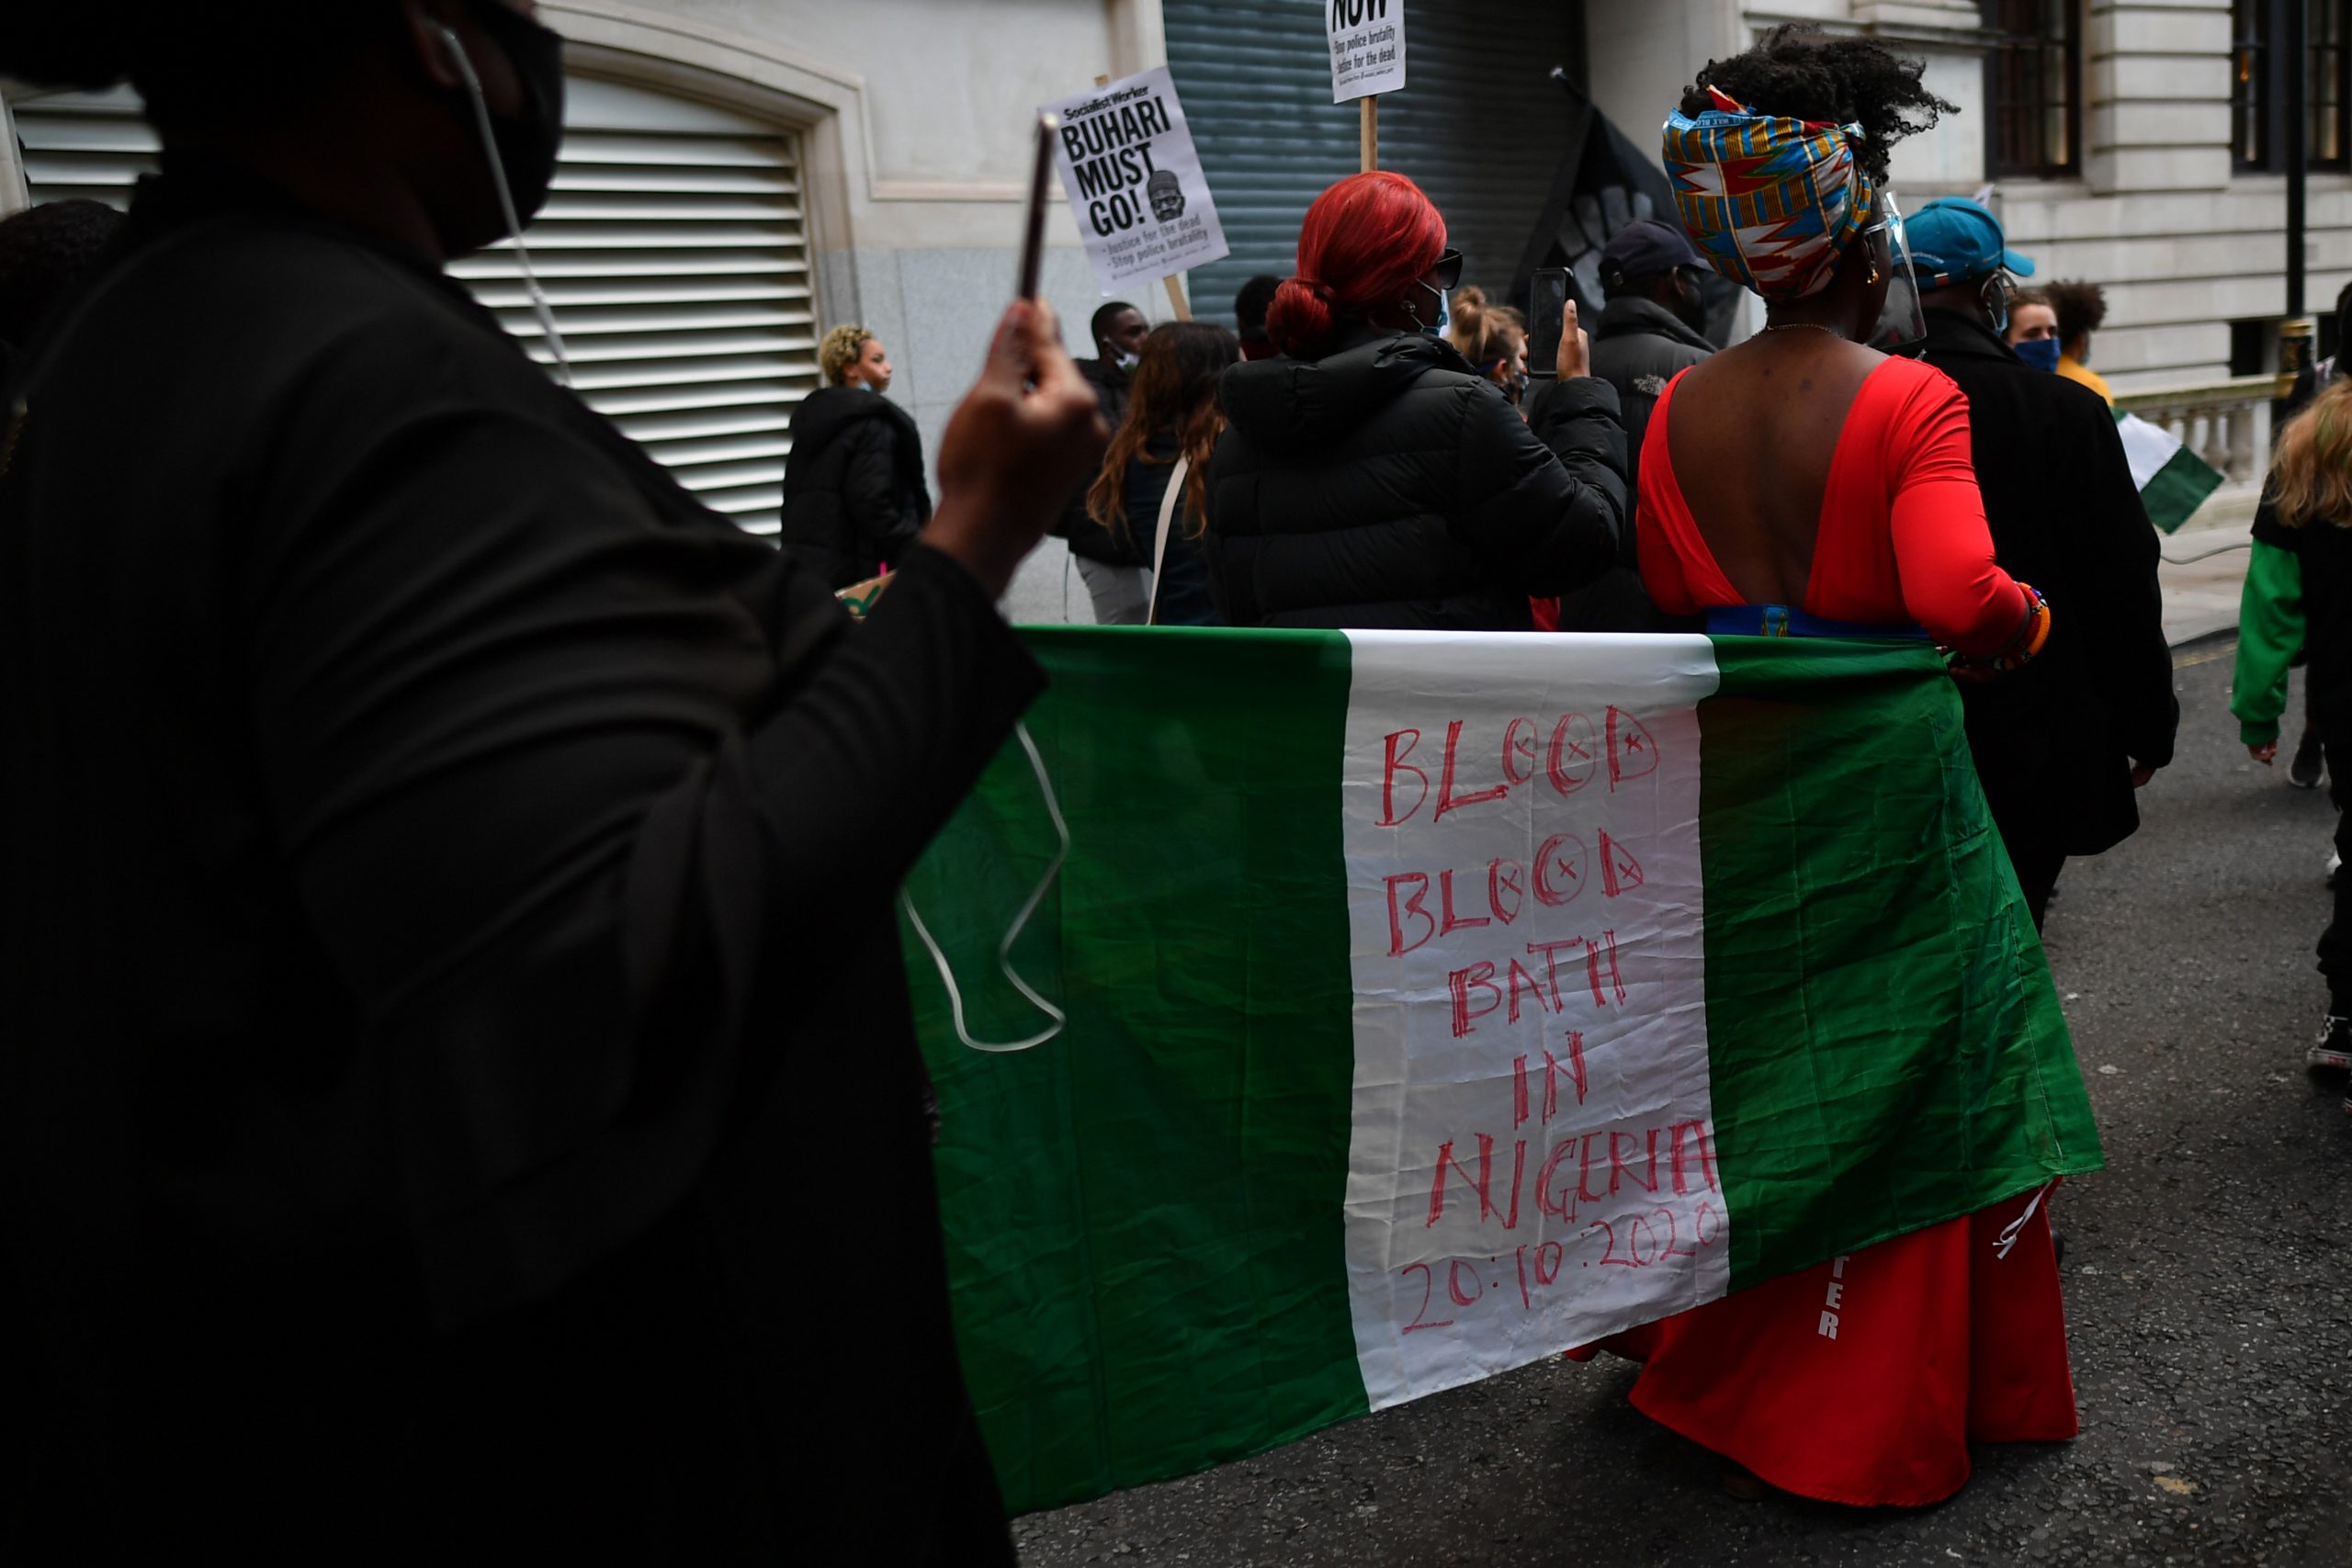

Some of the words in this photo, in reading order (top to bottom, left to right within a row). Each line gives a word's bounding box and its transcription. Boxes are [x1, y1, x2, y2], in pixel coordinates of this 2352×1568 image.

[1347, 34, 1367, 52] police
[1369, 25, 1396, 45] brutality
[1354, 54, 1364, 68] for
[1366, 51, 1377, 66] the
[1379, 44, 1396, 63] dead
[1060, 96, 1172, 163] BUHARI
[1073, 141, 1156, 200] MUST
[1090, 189, 1146, 237] GO!
[1143, 230, 1158, 243] for
[1159, 223, 1177, 238] the
[1179, 213, 1201, 231] dead
[1111, 254, 1135, 268] Stop
[1136, 243, 1166, 262] police
[1167, 228, 1209, 250] brutality
[1374, 705, 1661, 827] BLOOD
[1382, 828, 1645, 958] BLOOD
[1448, 928, 1627, 1039] BATH
[1513, 1032, 1589, 1131] IN
[1426, 1119, 1717, 1229] NIGERIA
